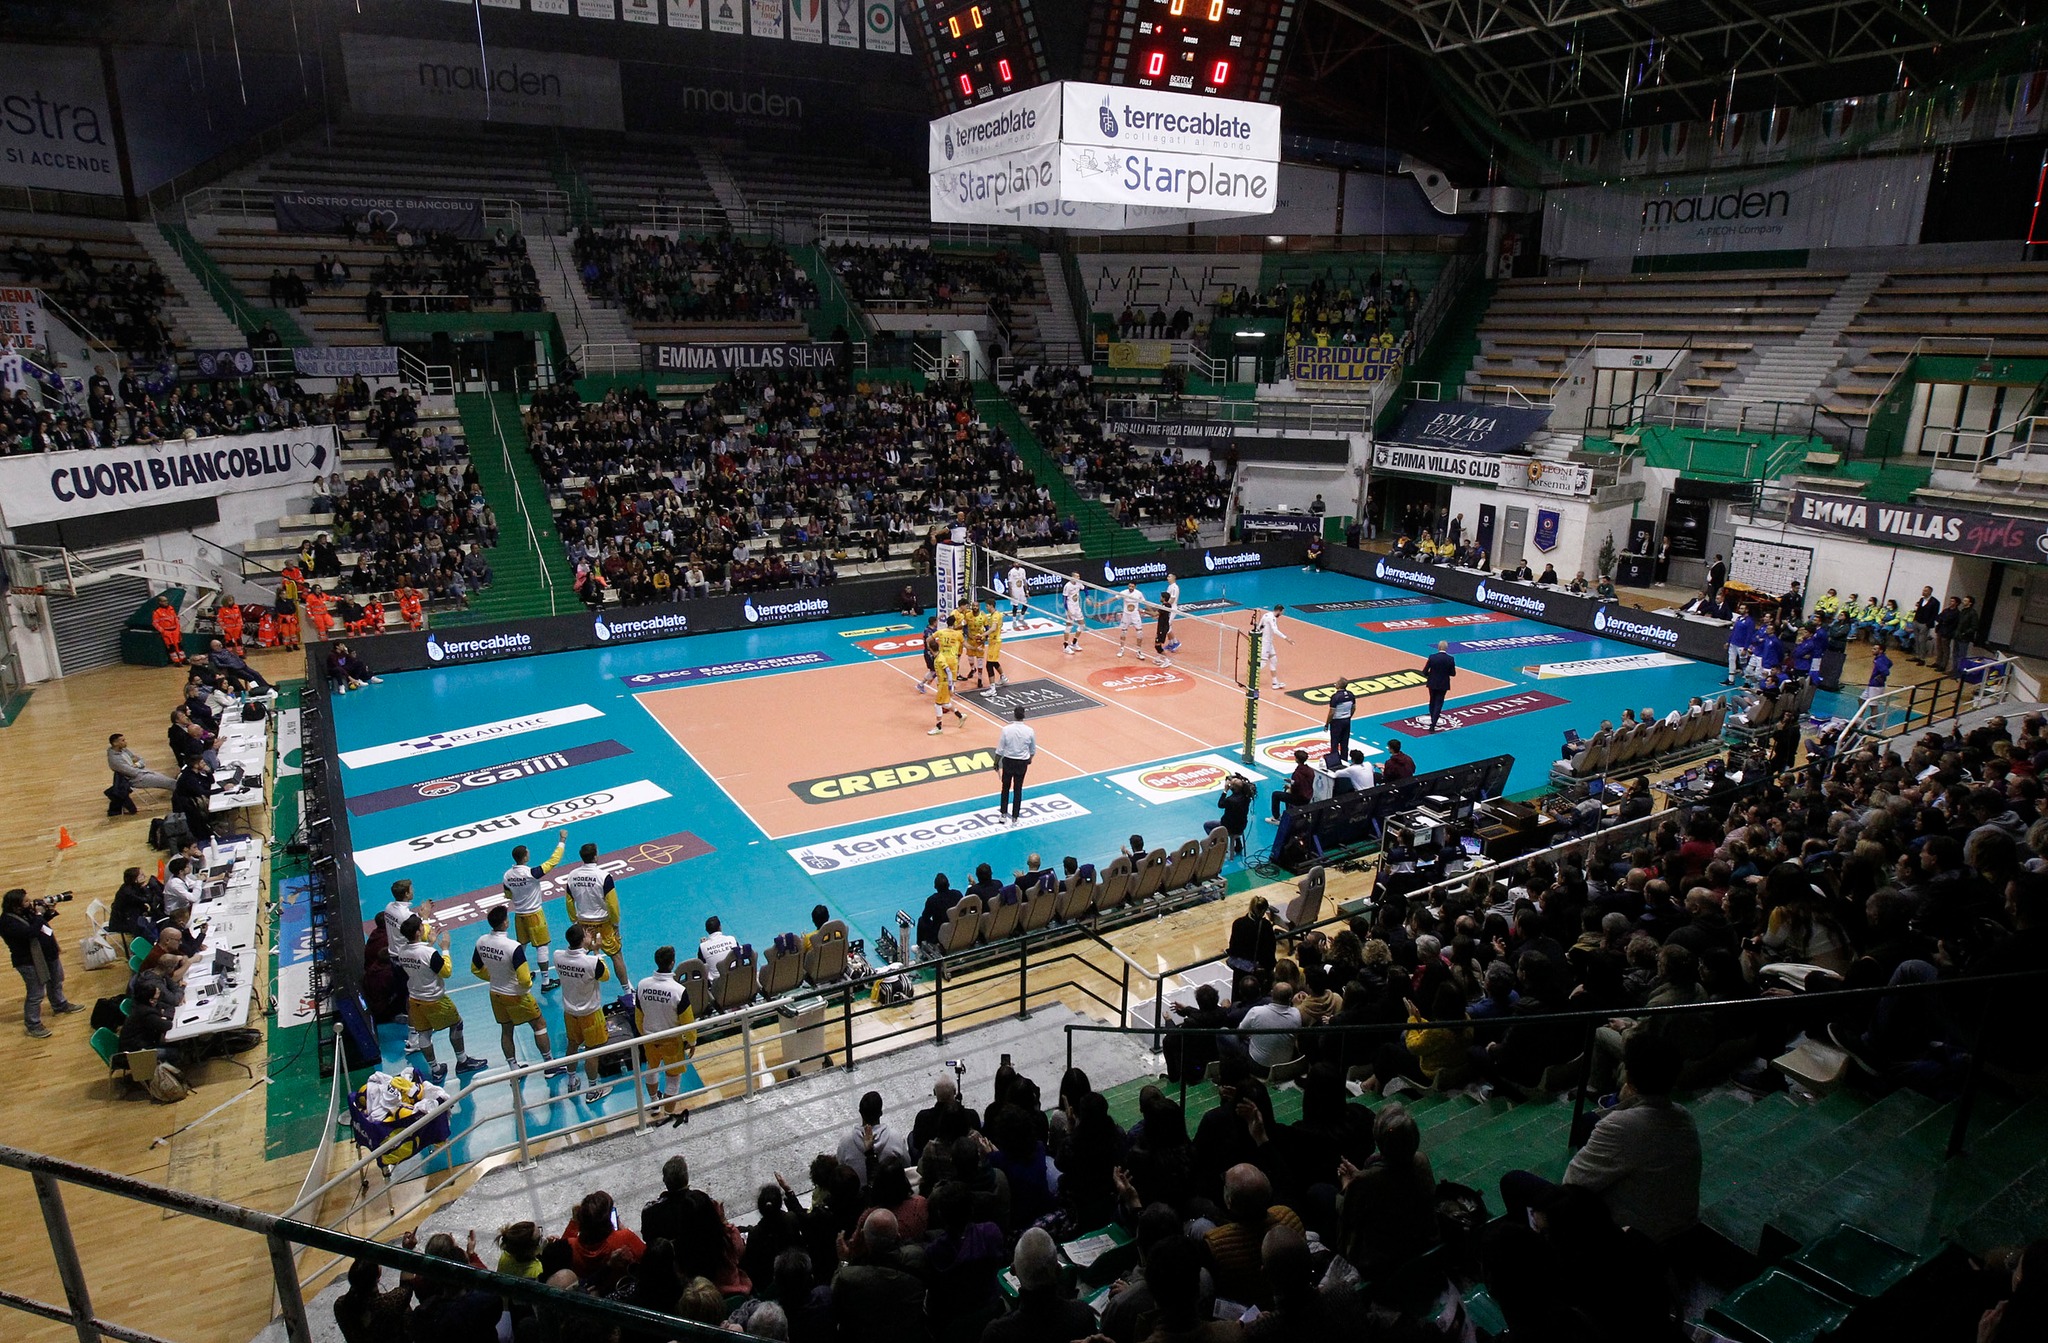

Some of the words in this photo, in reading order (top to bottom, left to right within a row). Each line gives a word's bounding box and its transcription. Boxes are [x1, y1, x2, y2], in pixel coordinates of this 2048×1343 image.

[949, 16, 961, 38] 0
[970, 6, 983, 29] 0
[1000, 59, 1012, 81] 0
[1149, 52, 1164, 75] 0
[1214, 61, 1228, 83] 0
[419, 62, 561, 97] mauden
[960, 74, 972, 95] 0
[682, 85, 801, 118] mauden
[0, 90, 106, 146] stra
[956, 107, 1036, 147] terrecablate
[1123, 104, 1251, 140] terrecablate
[1125, 131, 1187, 145] collegati
[1213, 140, 1251, 151] mondo
[7, 148, 25, 164] SI
[31, 151, 111, 174] ACCENDE
[960, 160, 1053, 206] Starplane
[1123, 155, 1267, 204] Starplane
[283, 195, 295, 204] IL
[297, 195, 349, 207] NOSTRO
[350, 198, 394, 209] CUORE
[406, 200, 474, 211] BIANCOBLU
[1641, 182, 1790, 225] mauden
[1738, 223, 1784, 236] Company
[658, 345, 718, 369] EMMA
[721, 346, 784, 368] VILLAS
[788, 346, 836, 367] SIENA
[1129, 422, 1146, 434] ALLA
[1182, 425, 1203, 437] EMMA
[1204, 426, 1227, 438] VILLAS
[1422, 423, 1490, 443] VILLAS
[51, 457, 147, 502] CUORI
[146, 444, 292, 490] BIANCOBLU
[1391, 451, 1426, 471] EMMA
[1428, 455, 1467, 476] VILLAS
[1469, 459, 1501, 480] CLUB
[1542, 464, 1573, 477] LEONI
[1802, 497, 1867, 529] EMMA
[1877, 508, 1962, 542] VILLAS
[1967, 518, 2026, 555] girls
[1114, 561, 1168, 576] terrecablate
[1213, 551, 1261, 566] terrecablate
[1385, 564, 1436, 586] terrecablate
[758, 597, 829, 617] terrecablate
[1486, 587, 1546, 612] terrecablate
[609, 613, 687, 635] terrecablate
[1382, 619, 1429, 630] AVIS
[1446, 614, 1492, 624] AVIS
[1606, 615, 1679, 642] terrecablate
[443, 632, 531, 655] terrecablate
[445, 650, 487, 660] collegati
[698, 659, 752, 674] BANCA
[756, 652, 820, 666] CENTRO
[657, 670, 692, 679] BCC
[702, 664, 770, 677] TOSCANA
[770, 656, 825, 668] UMBRIA
[1455, 695, 1542, 719] TODINI
[450, 717, 549, 742] READYTEC
[809, 751, 995, 800] CREDEM
[1148, 774, 1176, 787] Del
[1176, 766, 1222, 782] Monte
[1177, 776, 1213, 789] Quality
[542, 808, 604, 829] Audi
[408, 814, 523, 852] Scotti
[572, 875, 597, 884] MODENA
[707, 940, 733, 951] MODENA
[556, 963, 586, 973] MODENA
[642, 988, 672, 998] MODENA
[643, 996, 670, 1005] VOLLEY
